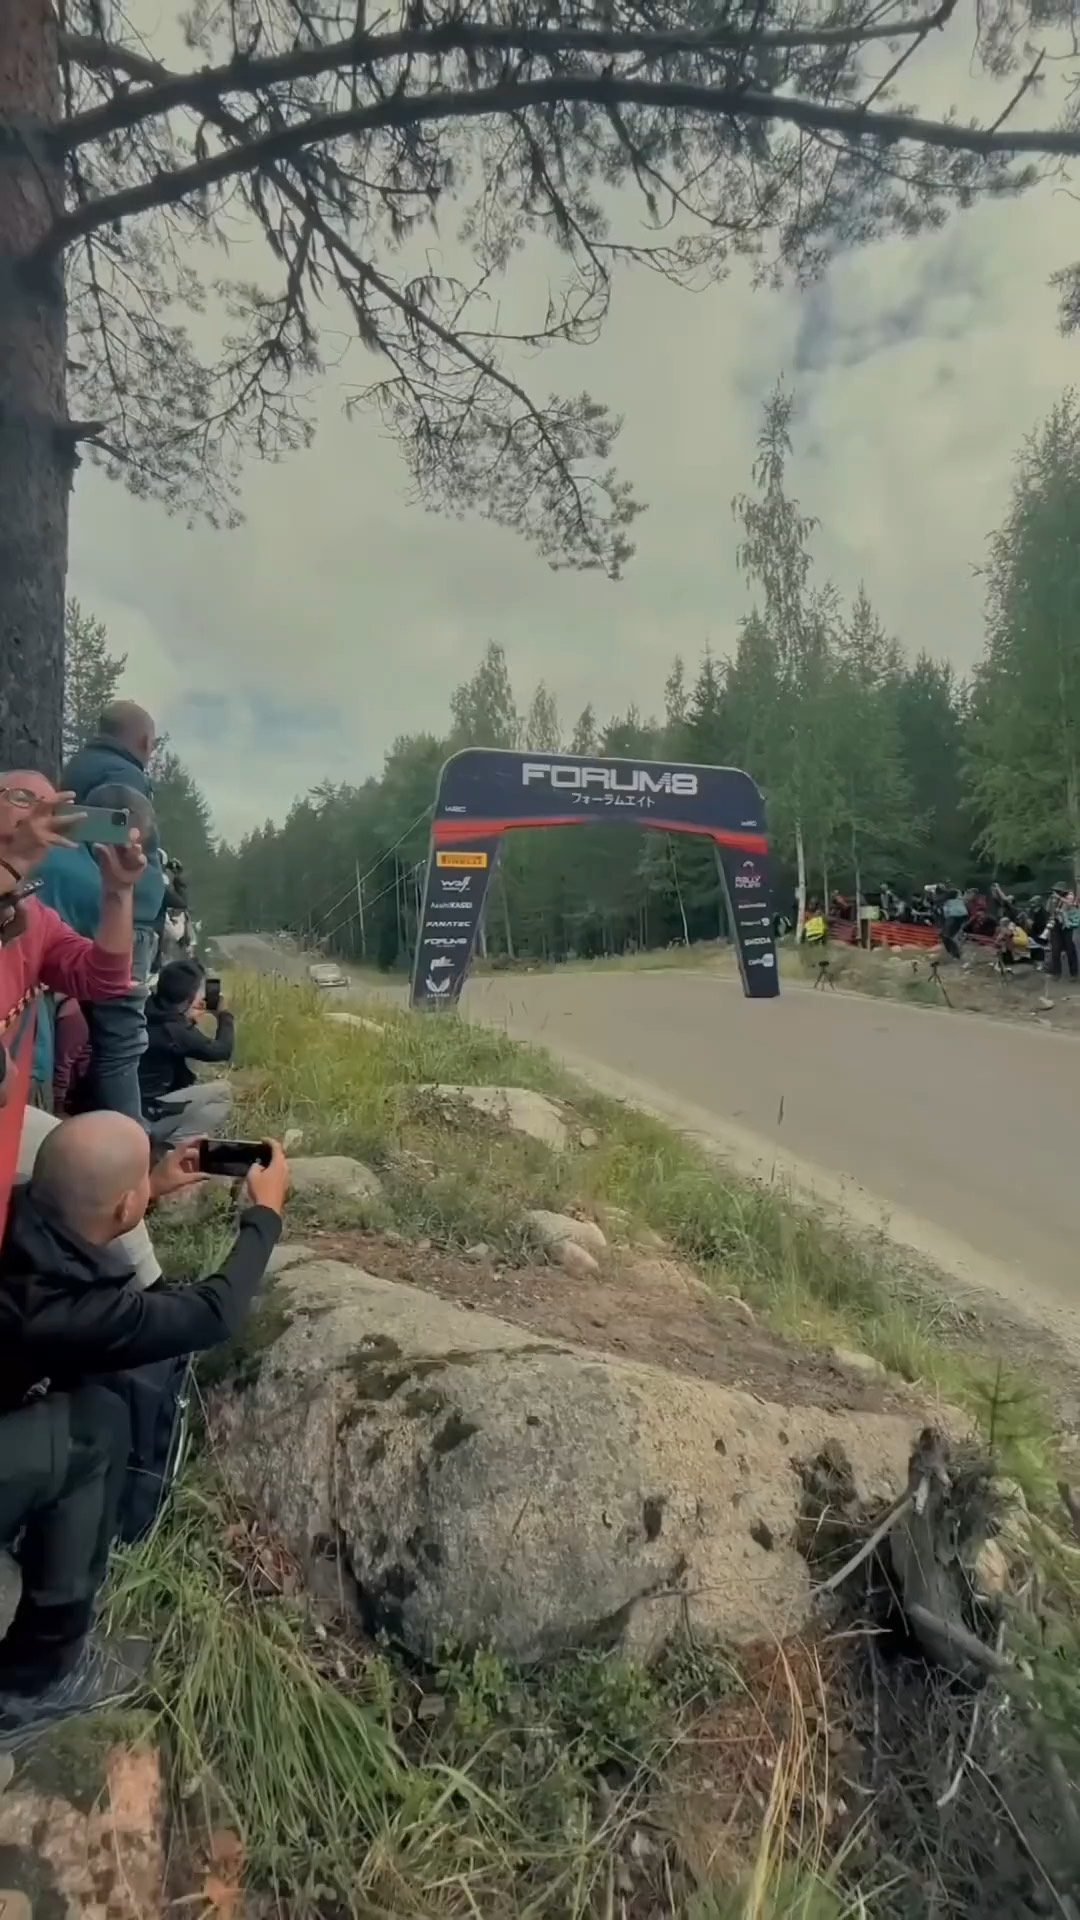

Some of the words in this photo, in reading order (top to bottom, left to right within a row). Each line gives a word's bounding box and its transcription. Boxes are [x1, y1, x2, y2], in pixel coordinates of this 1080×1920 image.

[522, 762, 698, 795] FORUM8
[571, 792, 655, 808] フォーラムエイト
[424, 937, 468, 945] FORUM8
